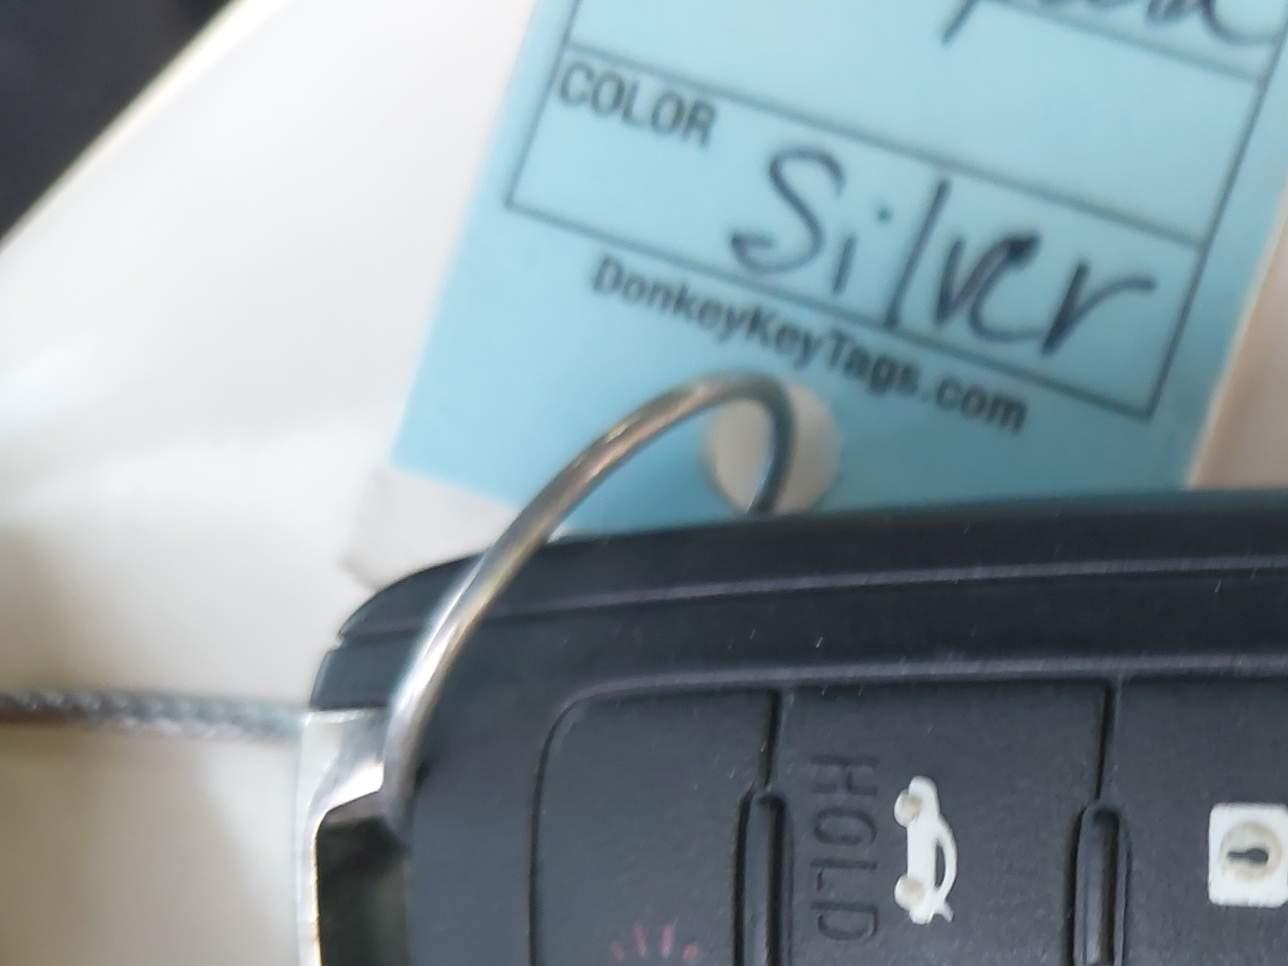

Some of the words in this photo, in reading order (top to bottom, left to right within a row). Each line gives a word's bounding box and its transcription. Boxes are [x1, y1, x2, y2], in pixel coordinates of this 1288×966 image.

[559, 61, 718, 148] COLOR
[729, 145, 1157, 357] Silver
[593, 255, 1030, 434] DonkeyKeyTags.com
[811, 753, 878, 942] HOLD
